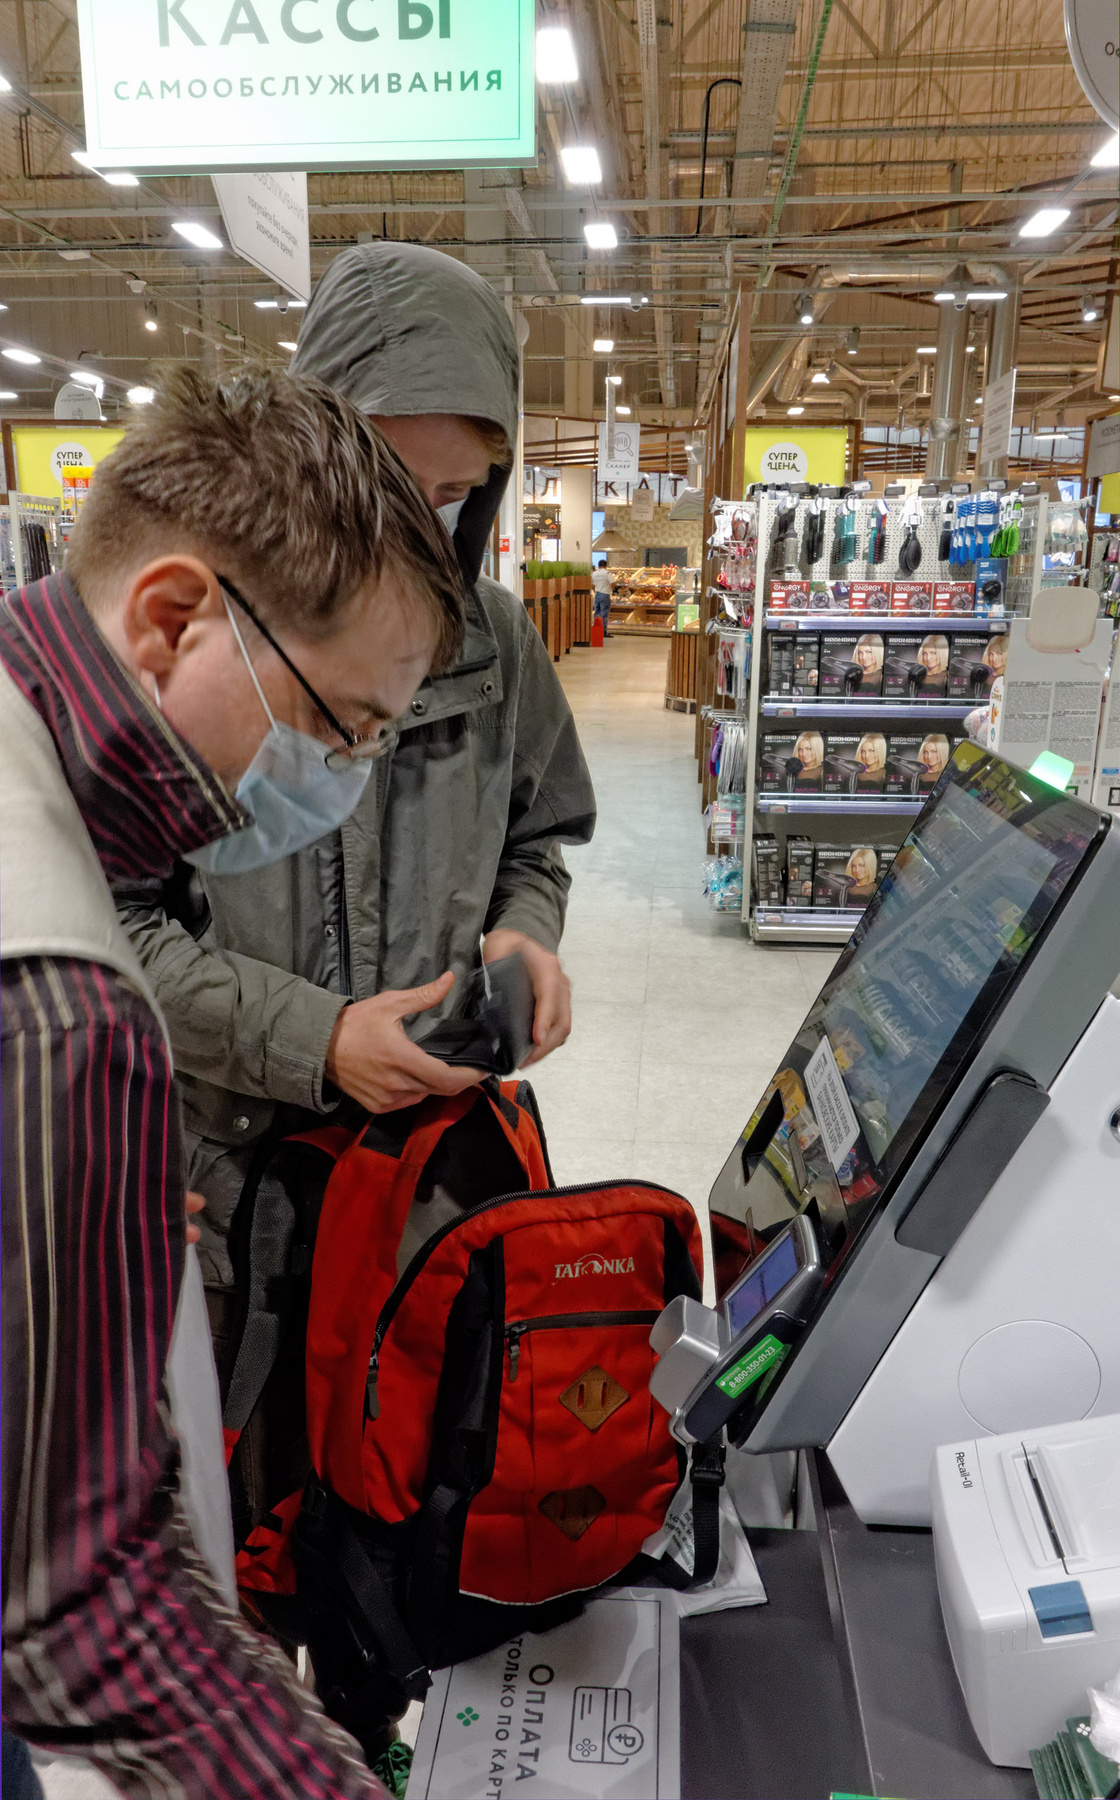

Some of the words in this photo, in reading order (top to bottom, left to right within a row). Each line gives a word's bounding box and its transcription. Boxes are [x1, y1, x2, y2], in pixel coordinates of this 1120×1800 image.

[157, 0, 451, 47] КАССЫ
[114, 69, 502, 101] САМООБСЛУЖИВАНИЯ
[56, 451, 83, 460] СУПЕР
[767, 461, 801, 472] ЦЕНА
[768, 452, 798, 461] СУПЕР
[729, 1346, 776, 1389] 8-800-350-01-23
[955, 1451, 973, 1489] Retail-01
[499, 1638, 523, 1708] ТОЛЬКО
[494, 1715, 511, 1741] ПО
[515, 1664, 555, 1781] ОПЛАТА
